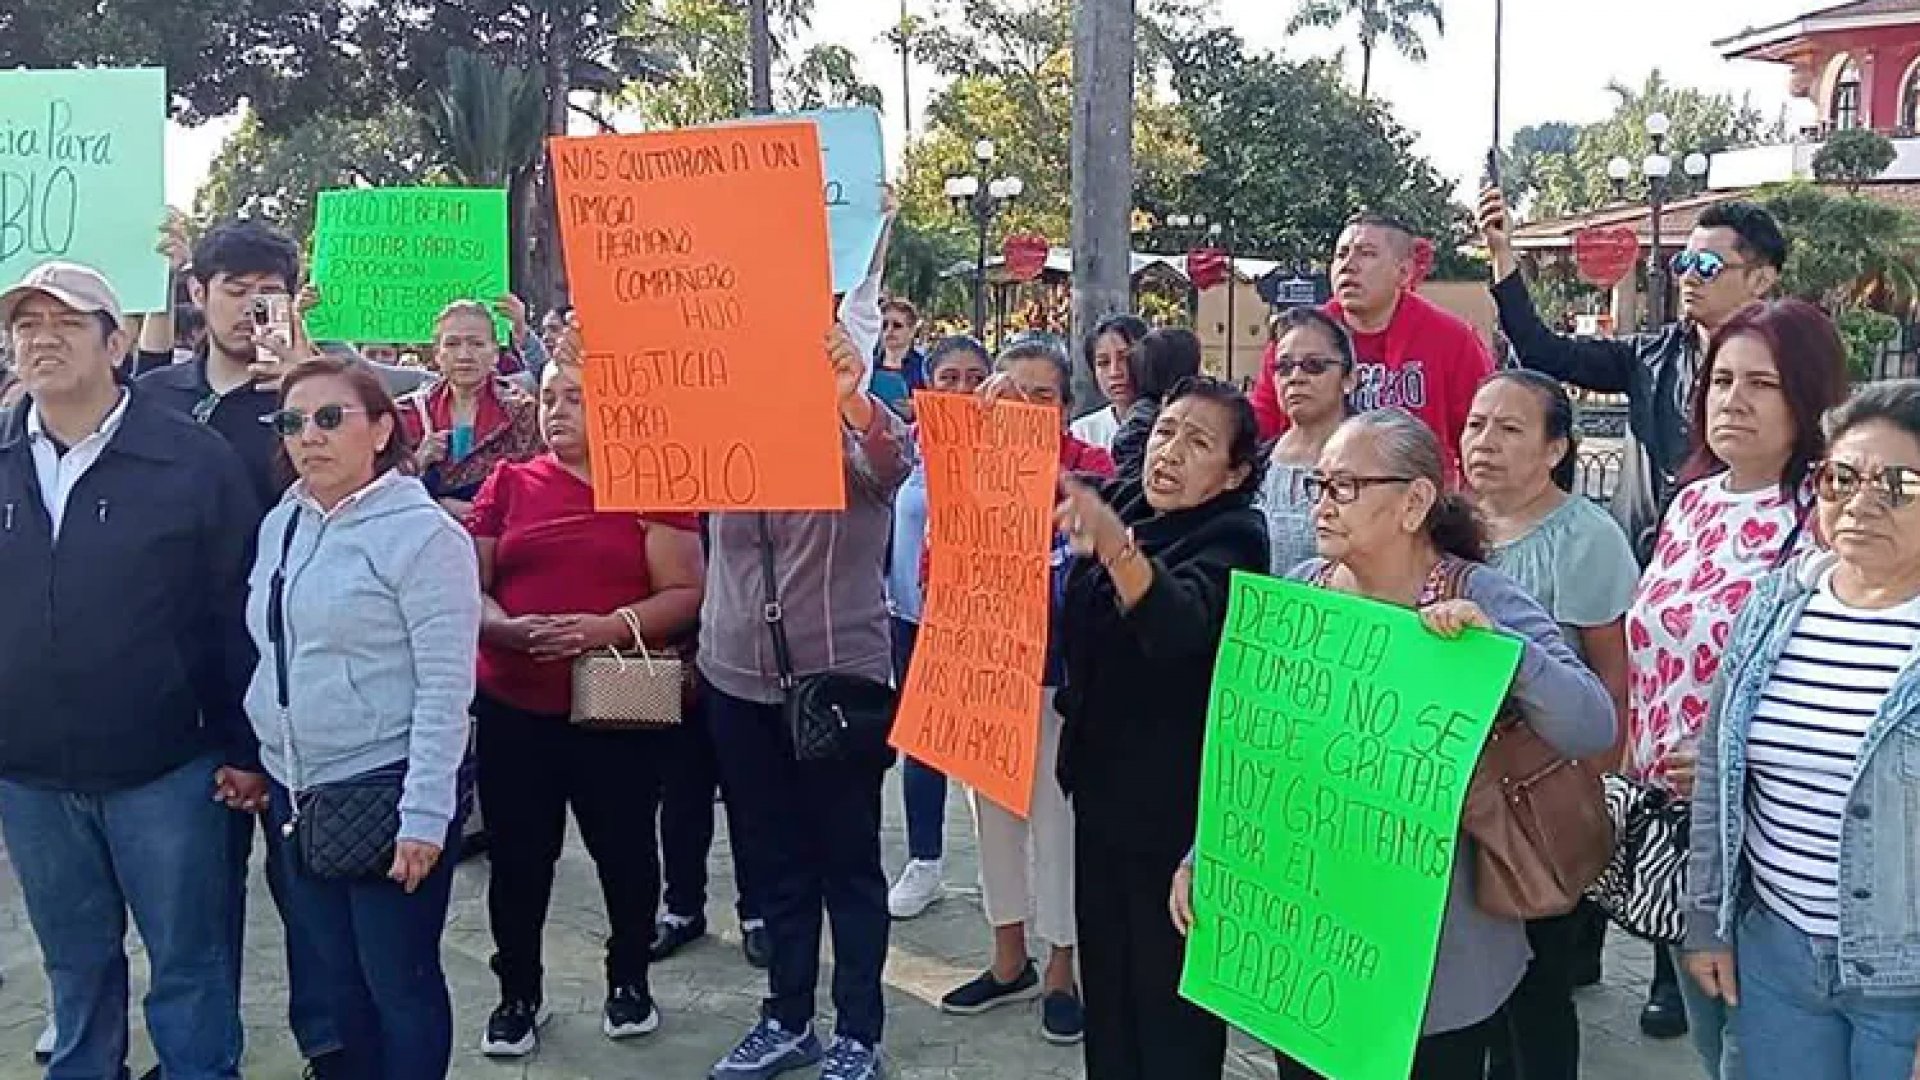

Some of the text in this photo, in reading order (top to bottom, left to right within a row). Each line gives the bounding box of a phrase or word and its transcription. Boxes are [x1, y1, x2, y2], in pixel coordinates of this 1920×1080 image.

[561, 141, 800, 181] NOS QUITARON A UN
[323, 192, 380, 226] PABLO
[569, 195, 635, 227] AMIGO
[412, 235, 457, 259] PARA
[459, 239, 485, 261] SU
[596, 227, 693, 264] HERMANO
[680, 295, 742, 330] HIJO
[585, 349, 728, 398] JUSTICIA
[598, 403, 669, 440] PARA
[918, 396, 960, 445] NOS
[603, 442, 756, 505] PABLO
[946, 449, 963, 494] A
[1234, 583, 1391, 676] DESDE LA
[916, 659, 949, 697] NOS
[1227, 636, 1478, 763] TUMBA NO SE
[916, 704, 933, 748] A
[1217, 687, 1459, 812] PUEDE GRITAR
[1215, 743, 1450, 879] HOY GRITAMOS
[1221, 810, 1265, 868] POR
[1199, 853, 1381, 982] JUSTICIA PARA
[1213, 913, 1336, 1030] PABLO
